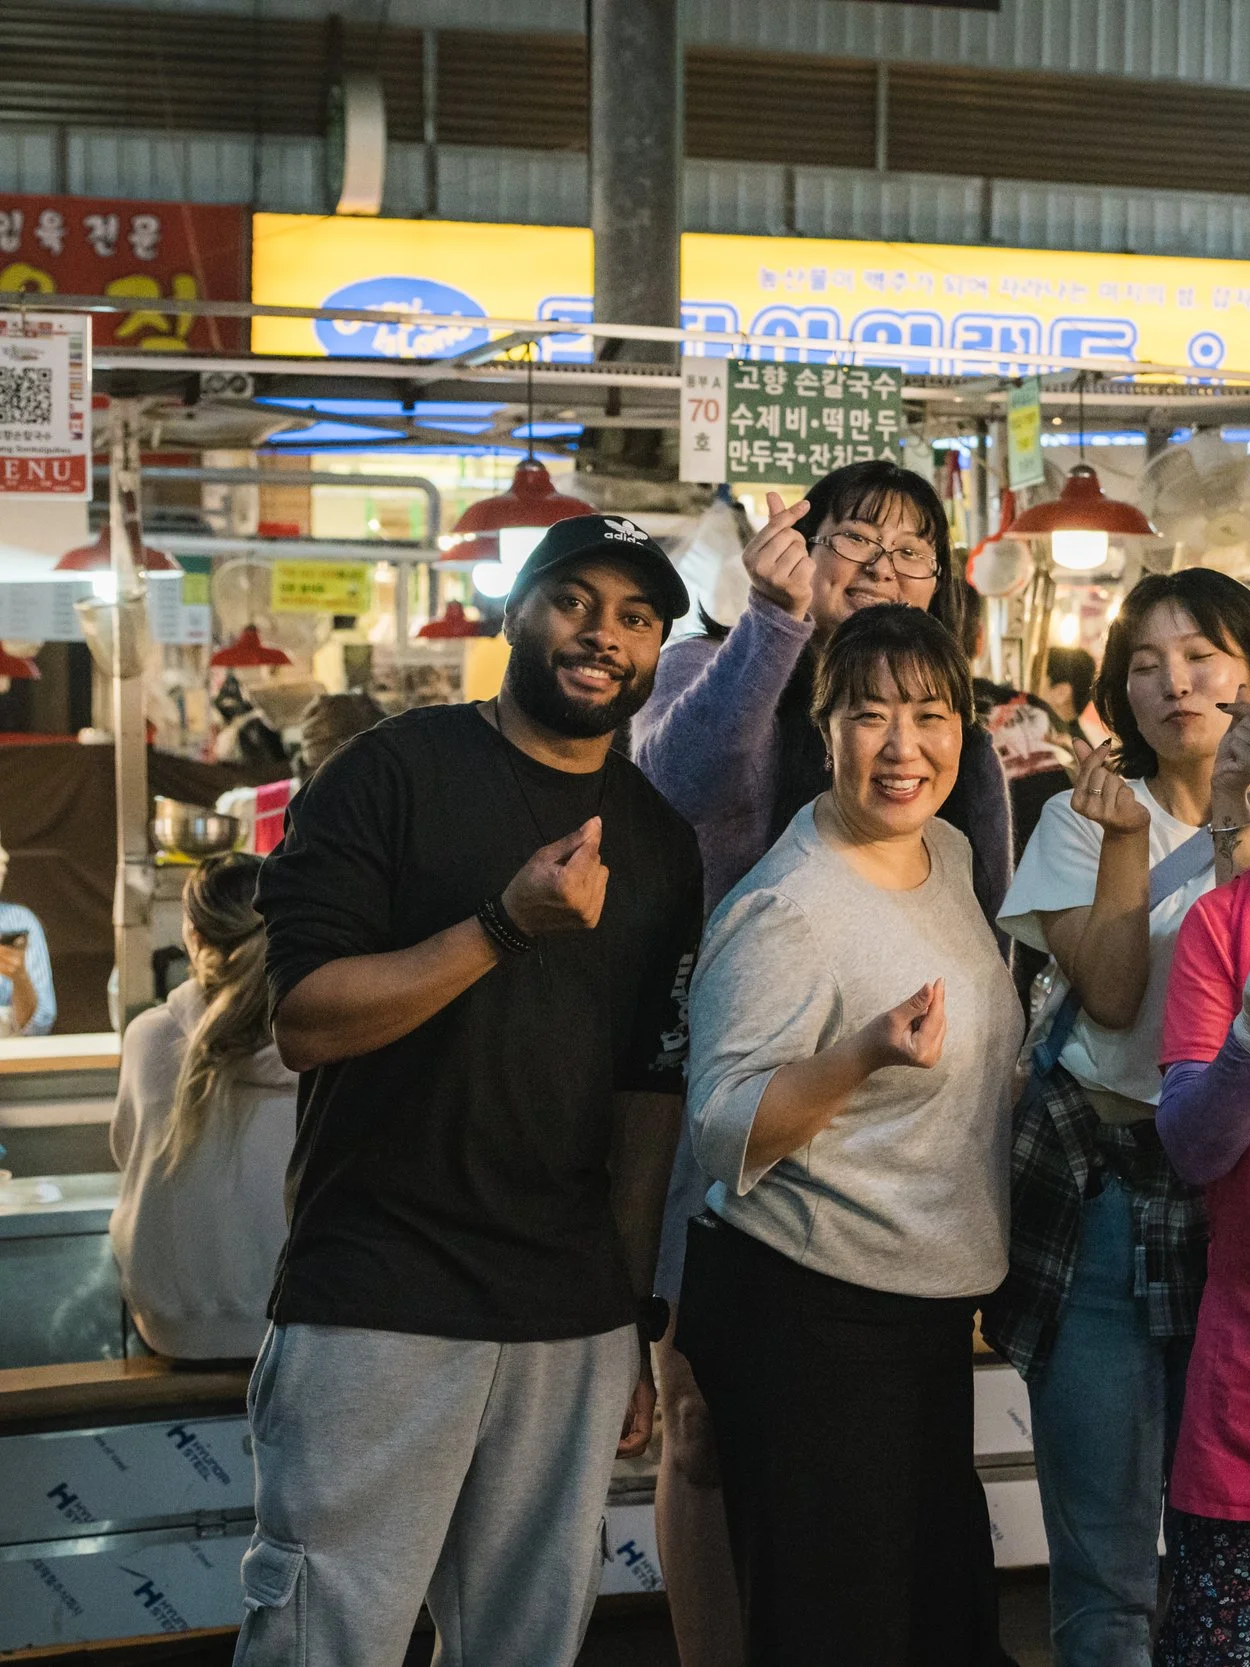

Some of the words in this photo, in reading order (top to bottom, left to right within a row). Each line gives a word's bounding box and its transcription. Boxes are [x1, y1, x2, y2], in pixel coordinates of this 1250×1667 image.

[734, 364, 788, 396] 고향
[794, 367, 898, 400] 손칼국수
[688, 398, 720, 423] 70
[693, 432, 711, 452] 호
[5, 459, 72, 482] ENU
[183, 1450, 210, 1482] STEEL
